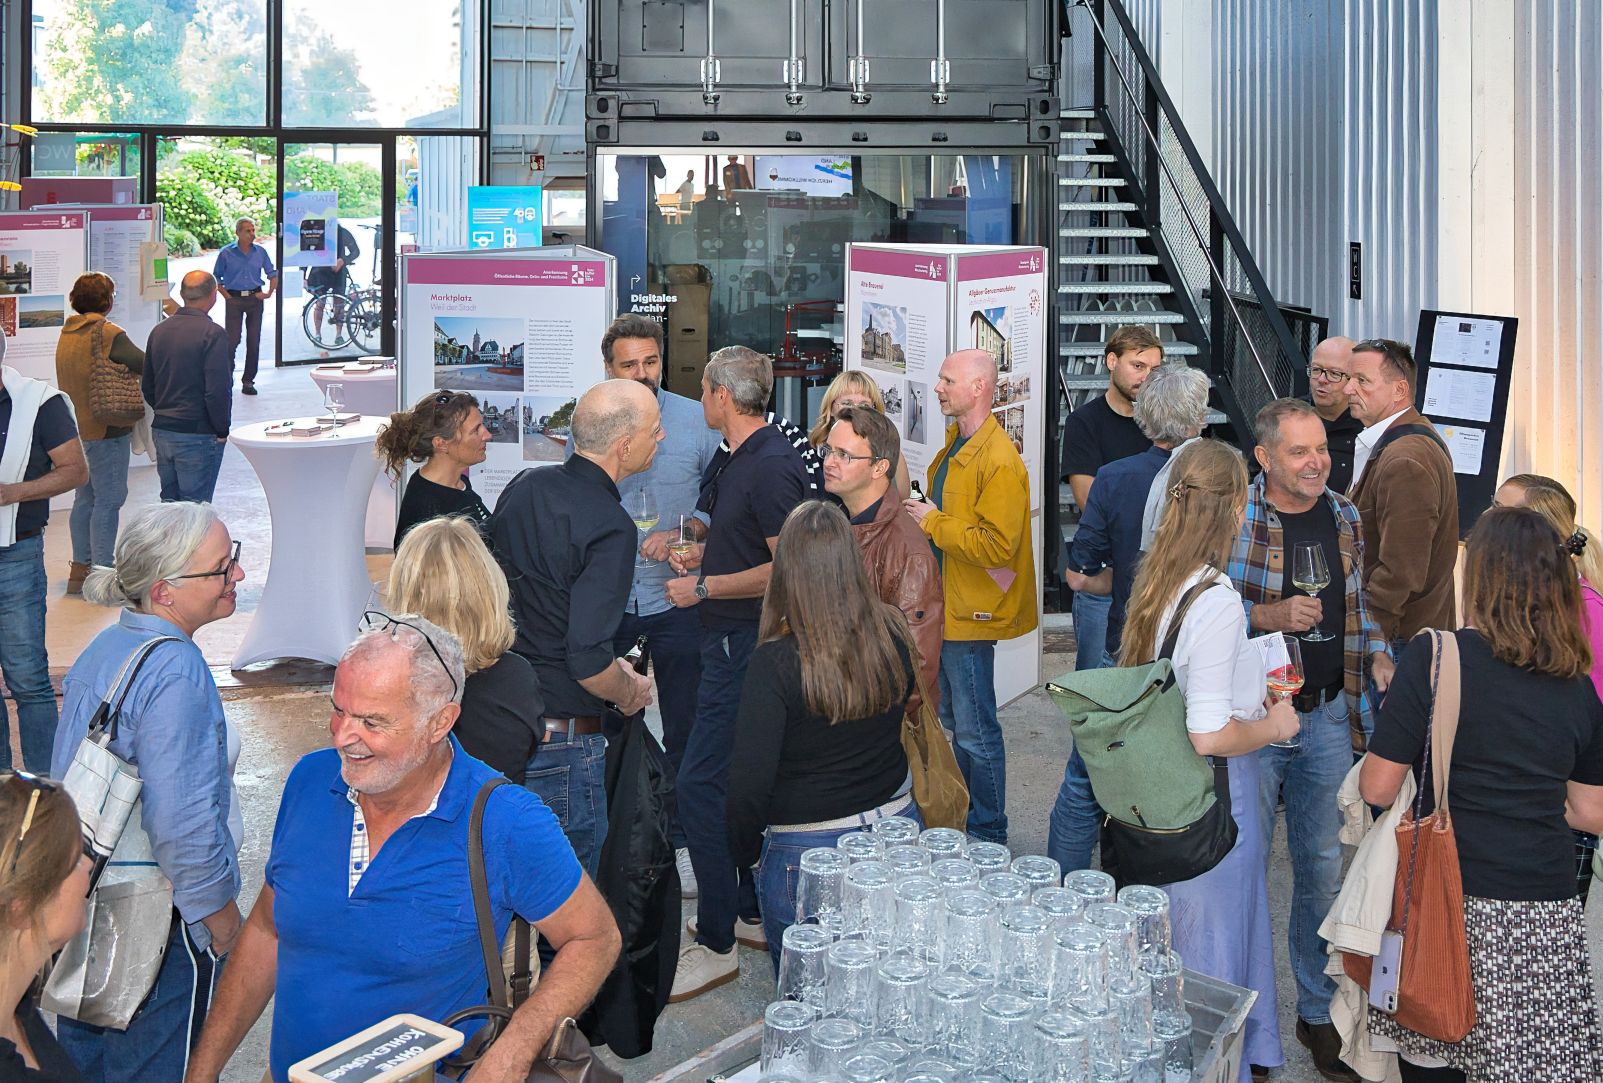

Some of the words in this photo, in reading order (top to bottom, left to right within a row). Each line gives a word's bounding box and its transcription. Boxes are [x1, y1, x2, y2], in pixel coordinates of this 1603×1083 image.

[430, 294, 472, 303] Marktplatz
[631, 294, 677, 303] Digitales
[430, 303, 445, 311] Weil
[459, 303, 477, 311] Stadt
[631, 304, 666, 312] Archiv
[374, 1045, 425, 1073] OHNE
